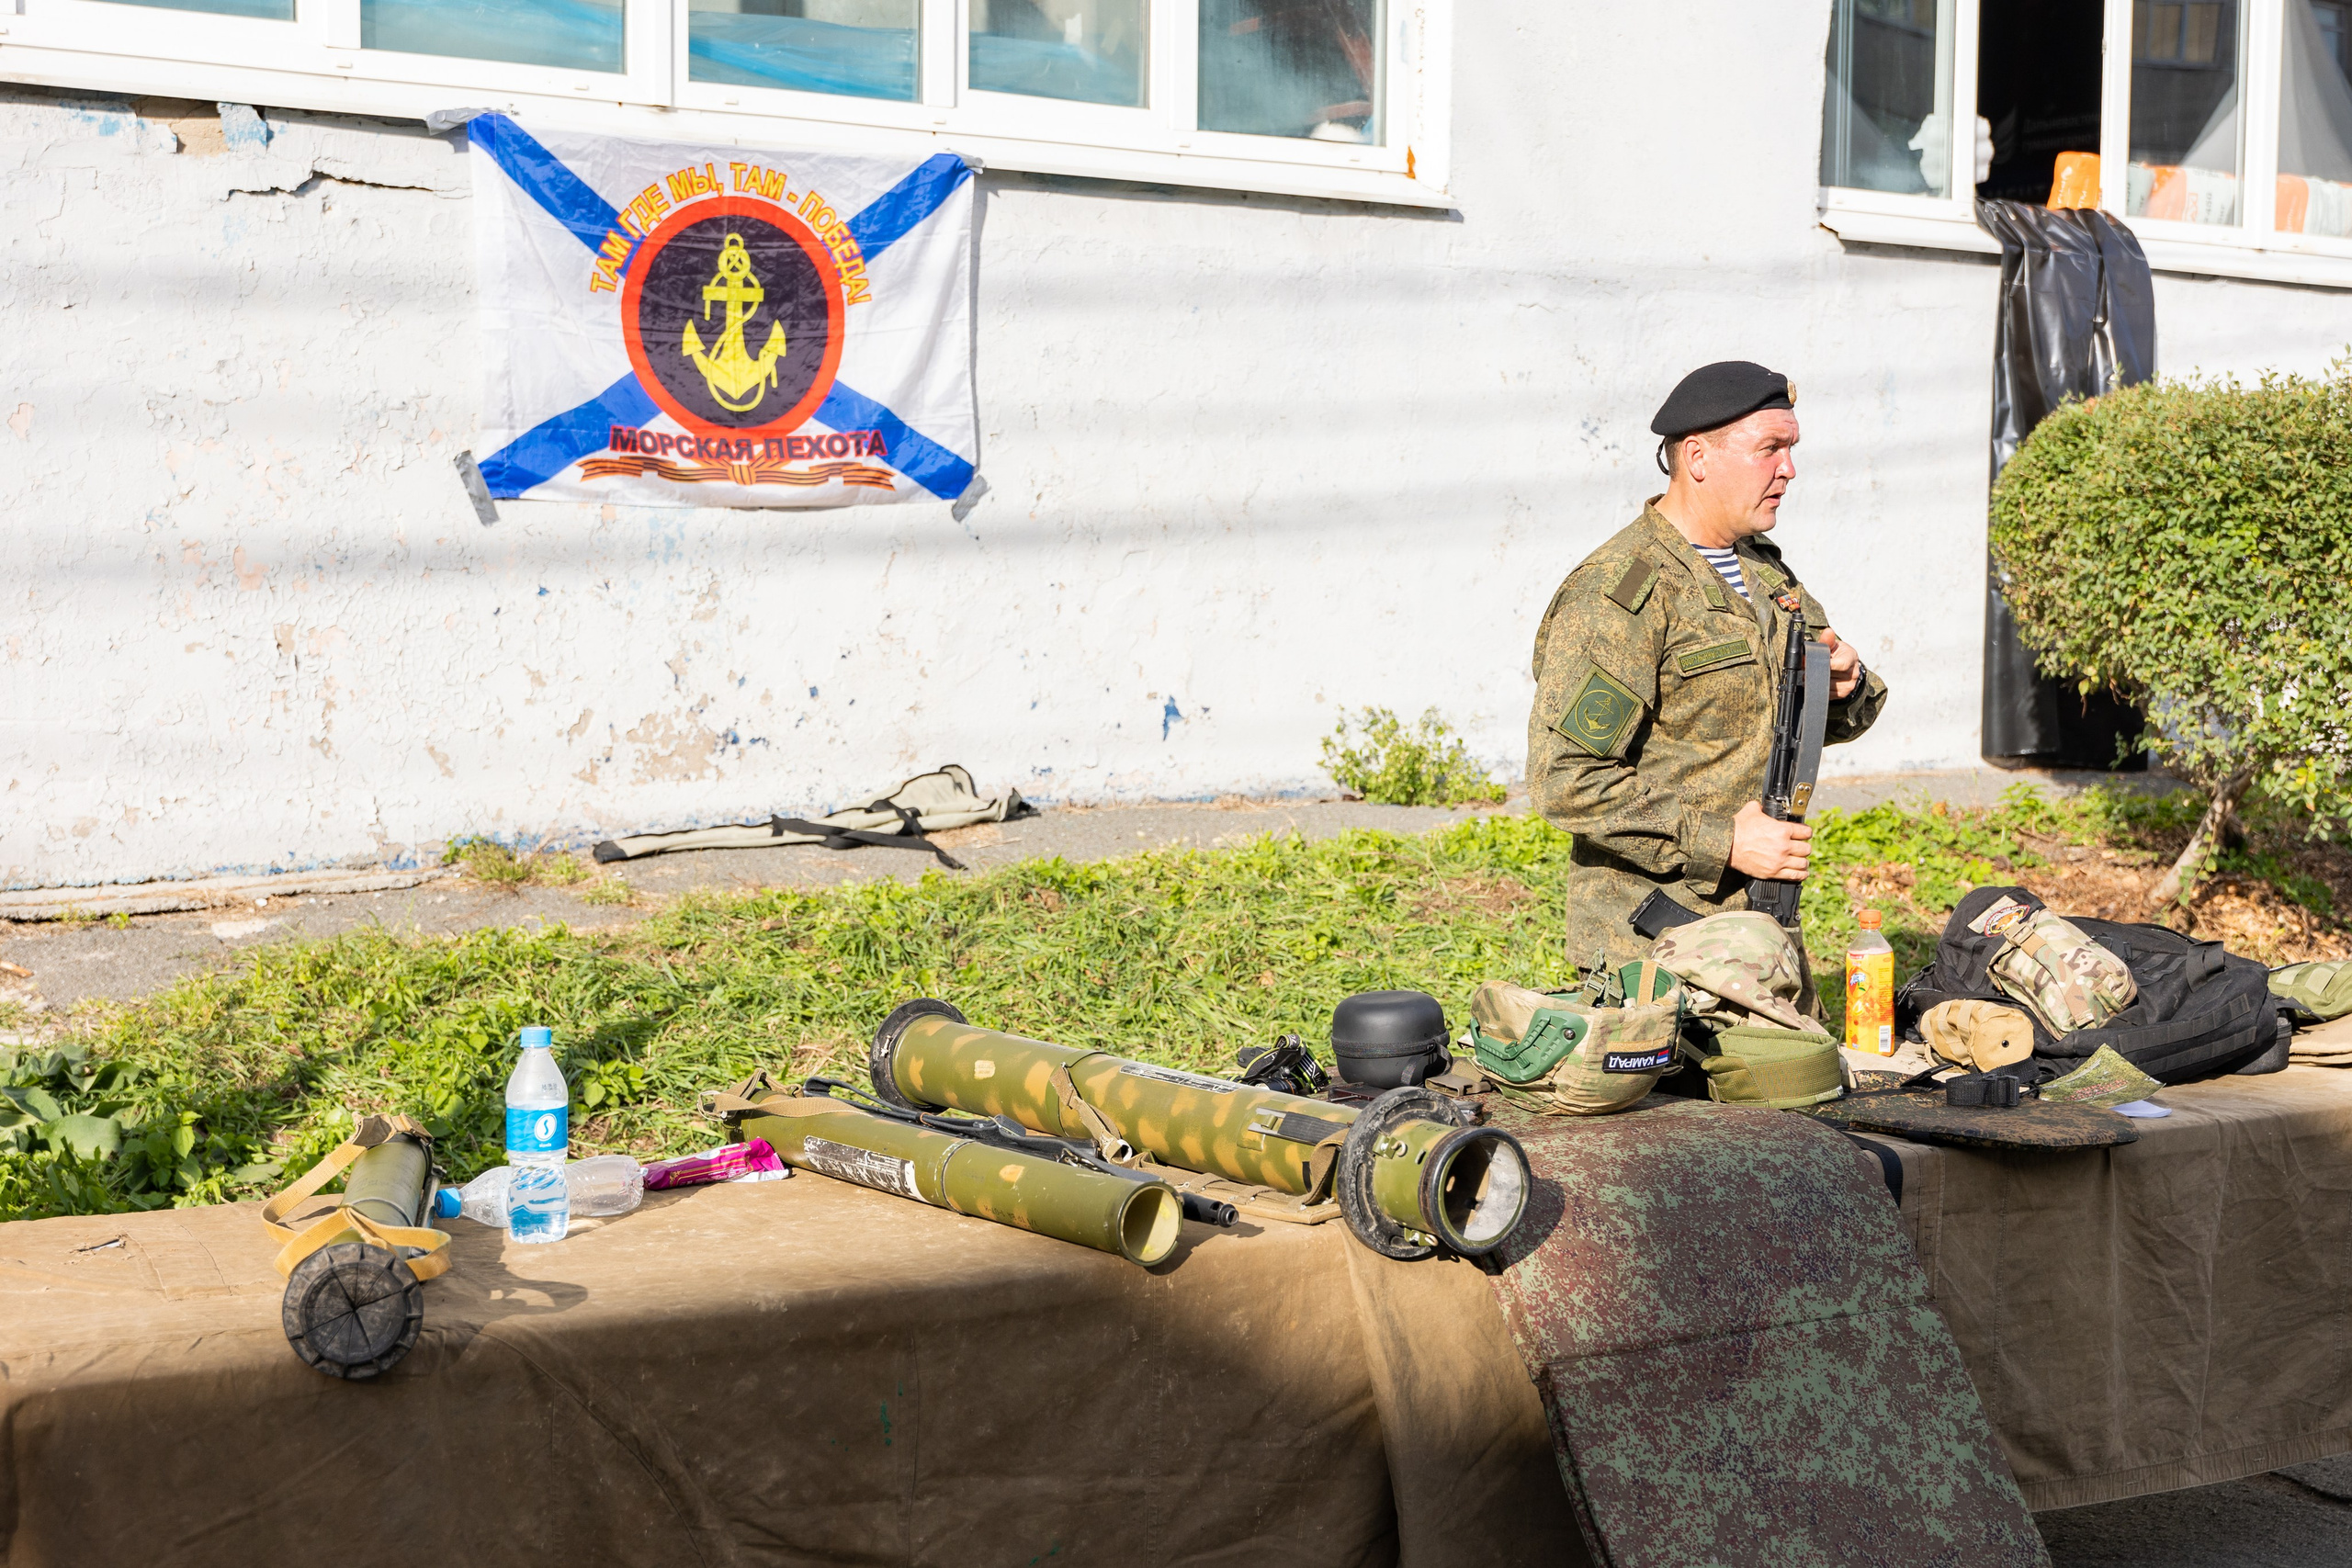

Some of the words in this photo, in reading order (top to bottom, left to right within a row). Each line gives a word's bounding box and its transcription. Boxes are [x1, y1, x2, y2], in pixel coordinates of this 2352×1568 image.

[590, 230, 633, 294] ТАМ
[616, 184, 671, 239] ГДЕ
[666, 163, 724, 203] МЫ,
[729, 162, 787, 201] ТАМ
[797, 190, 871, 305] ПОБЕДА!
[609, 425, 752, 460] МОРСКАЯ
[764, 429, 888, 460] ПЕХОТА
[1608, 1055, 1655, 1069] КАМРАД
